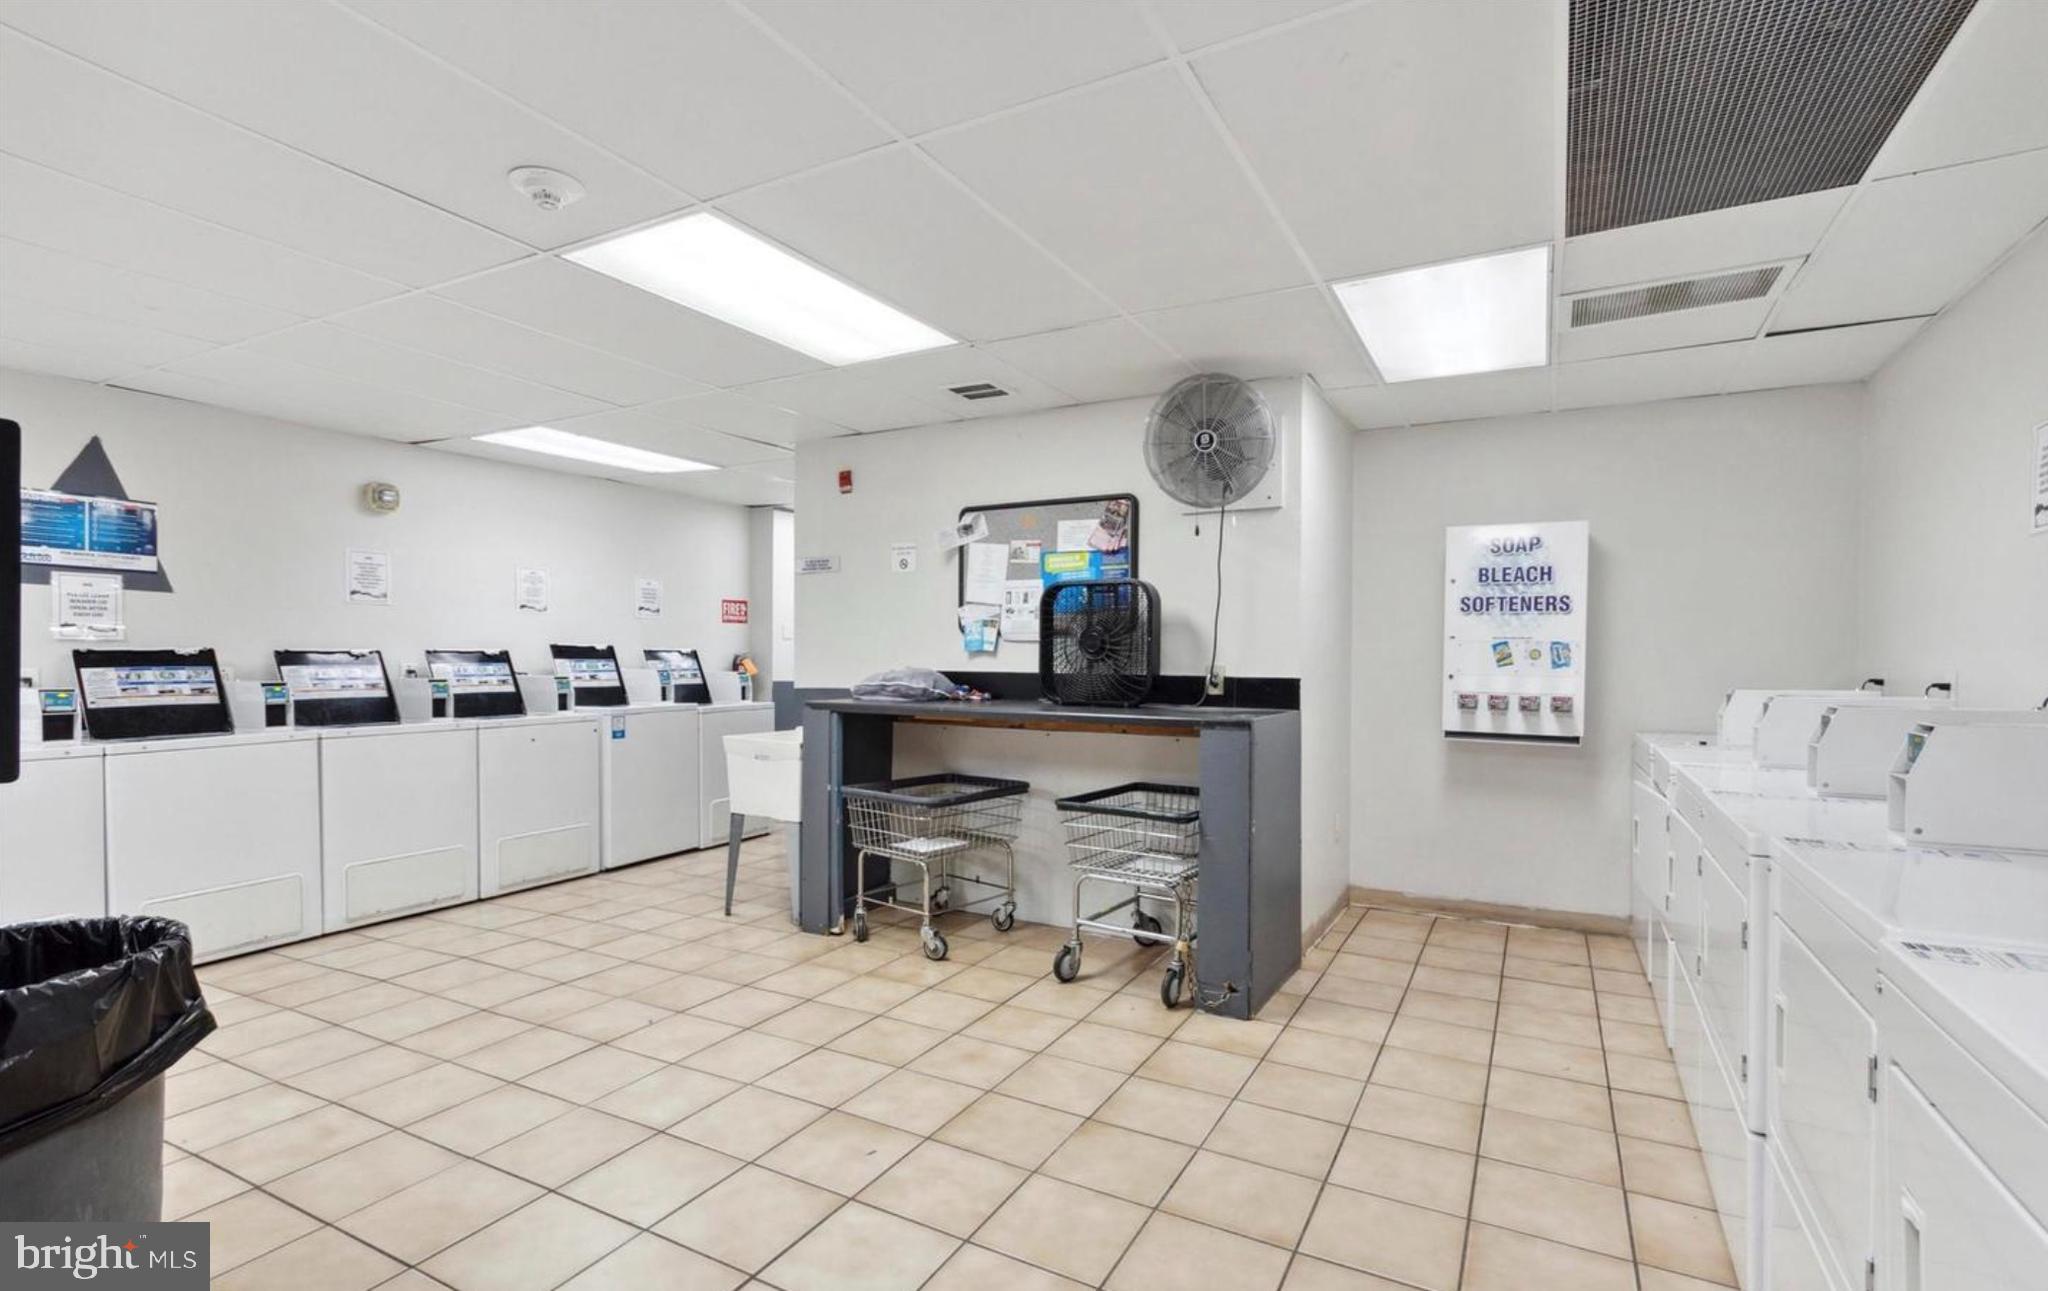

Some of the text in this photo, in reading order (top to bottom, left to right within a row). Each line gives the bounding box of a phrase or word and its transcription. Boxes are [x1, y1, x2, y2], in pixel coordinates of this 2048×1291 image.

[1490, 536, 1542, 554] SOAP
[1477, 566, 1553, 583] BLEACH
[1459, 595, 1572, 613] SOFTENERS
